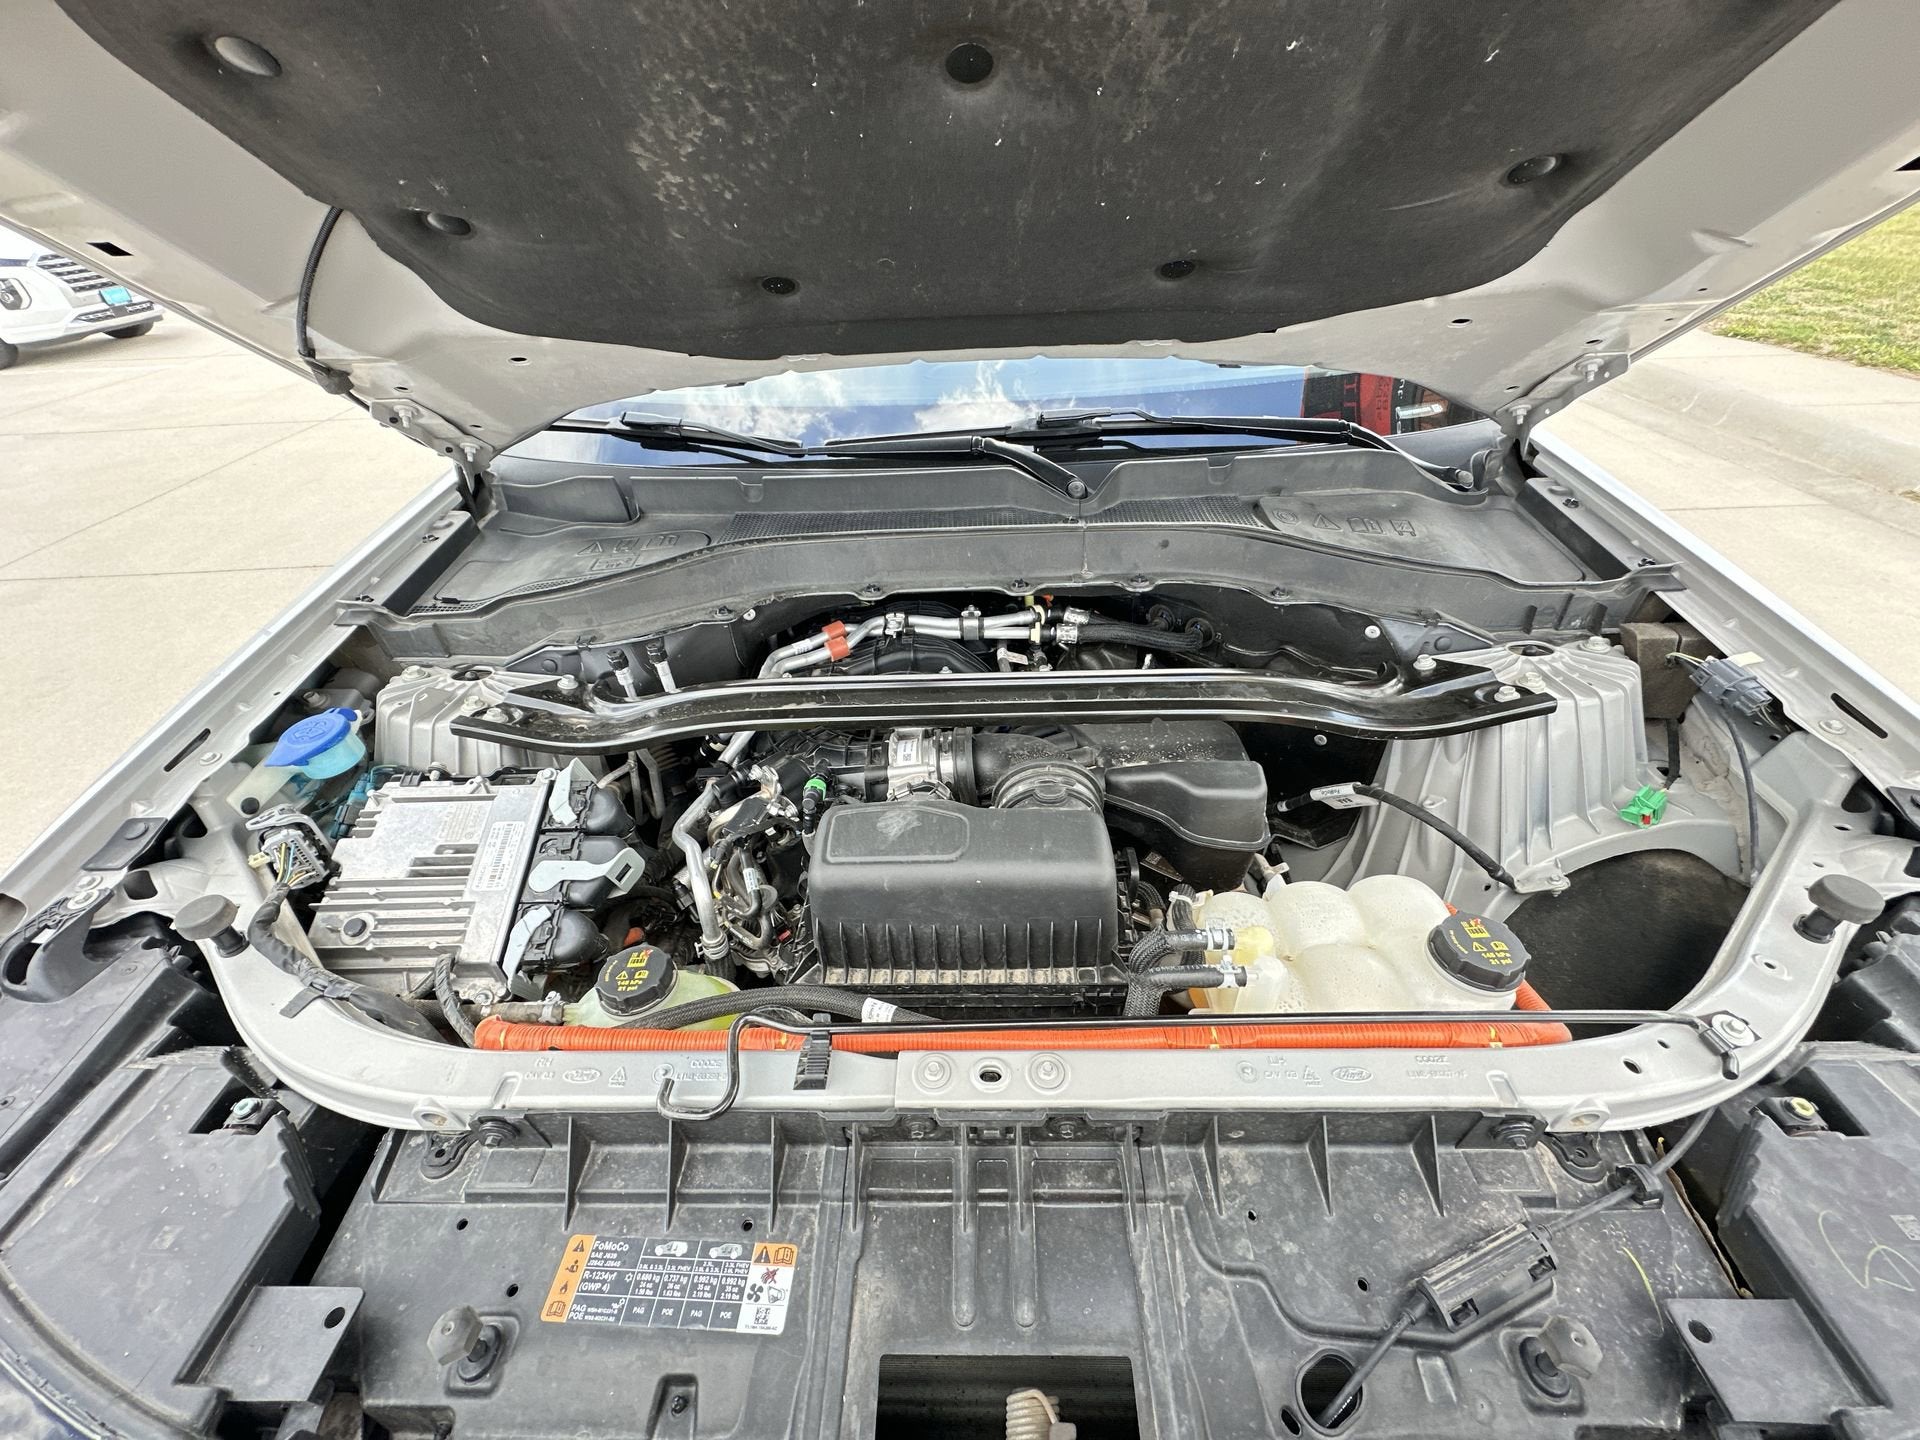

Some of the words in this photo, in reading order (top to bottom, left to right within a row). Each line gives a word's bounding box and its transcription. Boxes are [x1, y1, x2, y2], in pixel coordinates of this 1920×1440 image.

[593, 1241, 629, 1251] FoMoCo
[583, 1270, 617, 1282] R-1234yf
[652, 1273, 660, 1282] kg
[680, 1275, 688, 1284] kg
[710, 1276, 718, 1285] kg
[737, 1278, 745, 1287] kg
[578, 1282, 601, 1292] (GWP
[602, 1283, 610, 1293] 4)
[571, 1304, 586, 1312] PAG
[568, 1312, 584, 1320] POE
